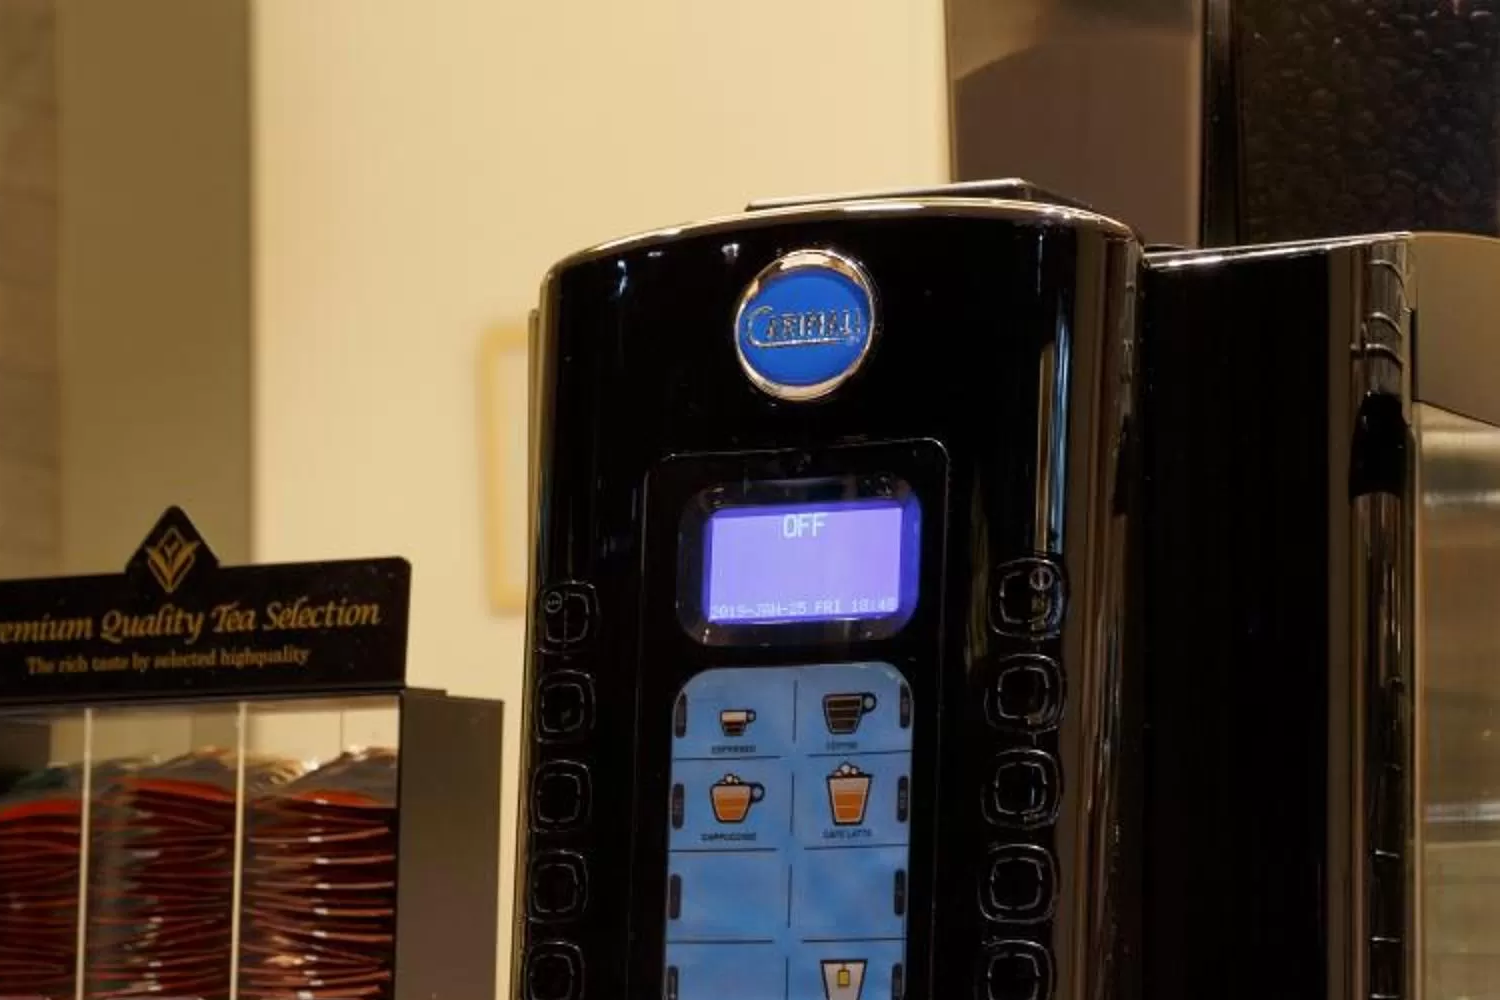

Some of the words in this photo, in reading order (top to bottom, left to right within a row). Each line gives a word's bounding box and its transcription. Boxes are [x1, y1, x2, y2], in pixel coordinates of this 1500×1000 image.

[782, 512, 828, 538] OFF
[100, 603, 204, 645] Quality
[211, 600, 257, 634] Tea
[261, 595, 383, 632] Selection
[25, 655, 54, 676] The
[58, 652, 88, 673] rich
[132, 651, 150, 673] by
